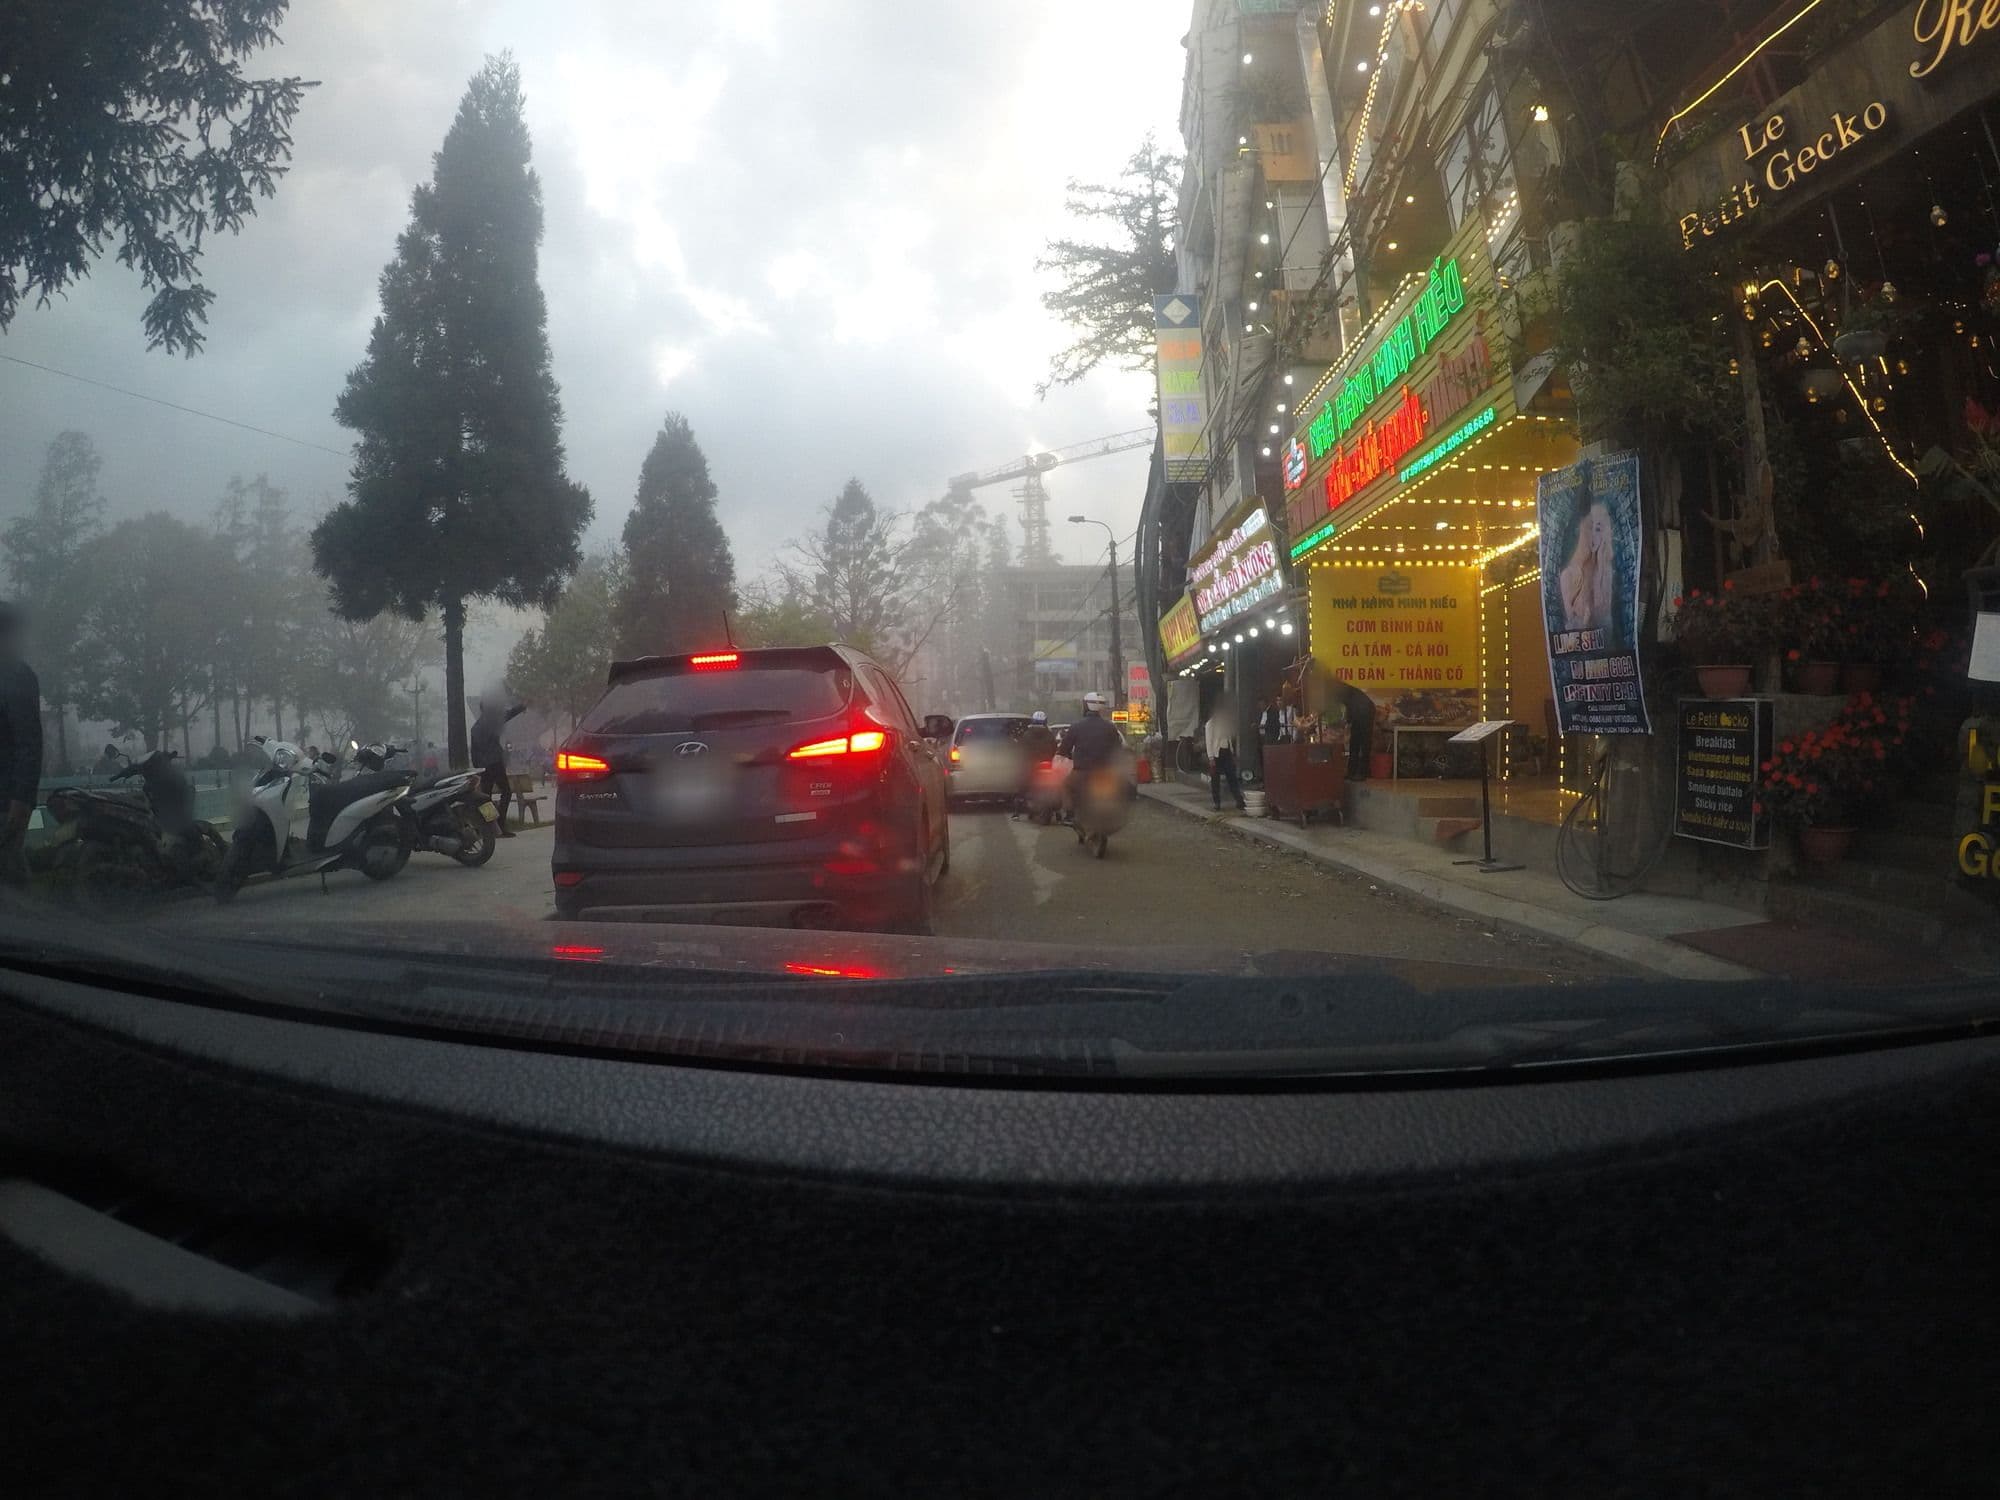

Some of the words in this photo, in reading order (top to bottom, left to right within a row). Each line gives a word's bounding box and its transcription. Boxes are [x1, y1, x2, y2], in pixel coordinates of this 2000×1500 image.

[1737, 114, 1786, 161] Le
[1765, 101, 1887, 191] Gecko
[1309, 400, 1335, 461] NHÀ
[1335, 363, 1374, 439] HÀNG
[1373, 314, 1416, 395] MINH
[1414, 256, 1464, 355] HIẾU
[1332, 595, 1357, 609] NHÀ
[1361, 595, 1394, 609] HÀNG
[1397, 597, 1427, 609] MINH
[1346, 620, 1376, 633] CƠM
[1381, 617, 1413, 633] BÌNH
[1417, 617, 1444, 633] DÂN
[1342, 641, 1359, 657] CÁ
[1364, 640, 1392, 657] TẦM
[1405, 641, 1423, 657] CÁ
[1446, 664, 1464, 681] CỐ
[1612, 681, 1638, 701] BAR
[1685, 711, 1697, 726] Le
[1698, 711, 1718, 727] Petit
[1695, 735, 1736, 749] Breakfast
[1687, 781, 1716, 795] Smoked
[1716, 783, 1743, 798] buffalo
[1695, 797, 1717, 812] Sticky
[1717, 800, 1734, 813] rice
